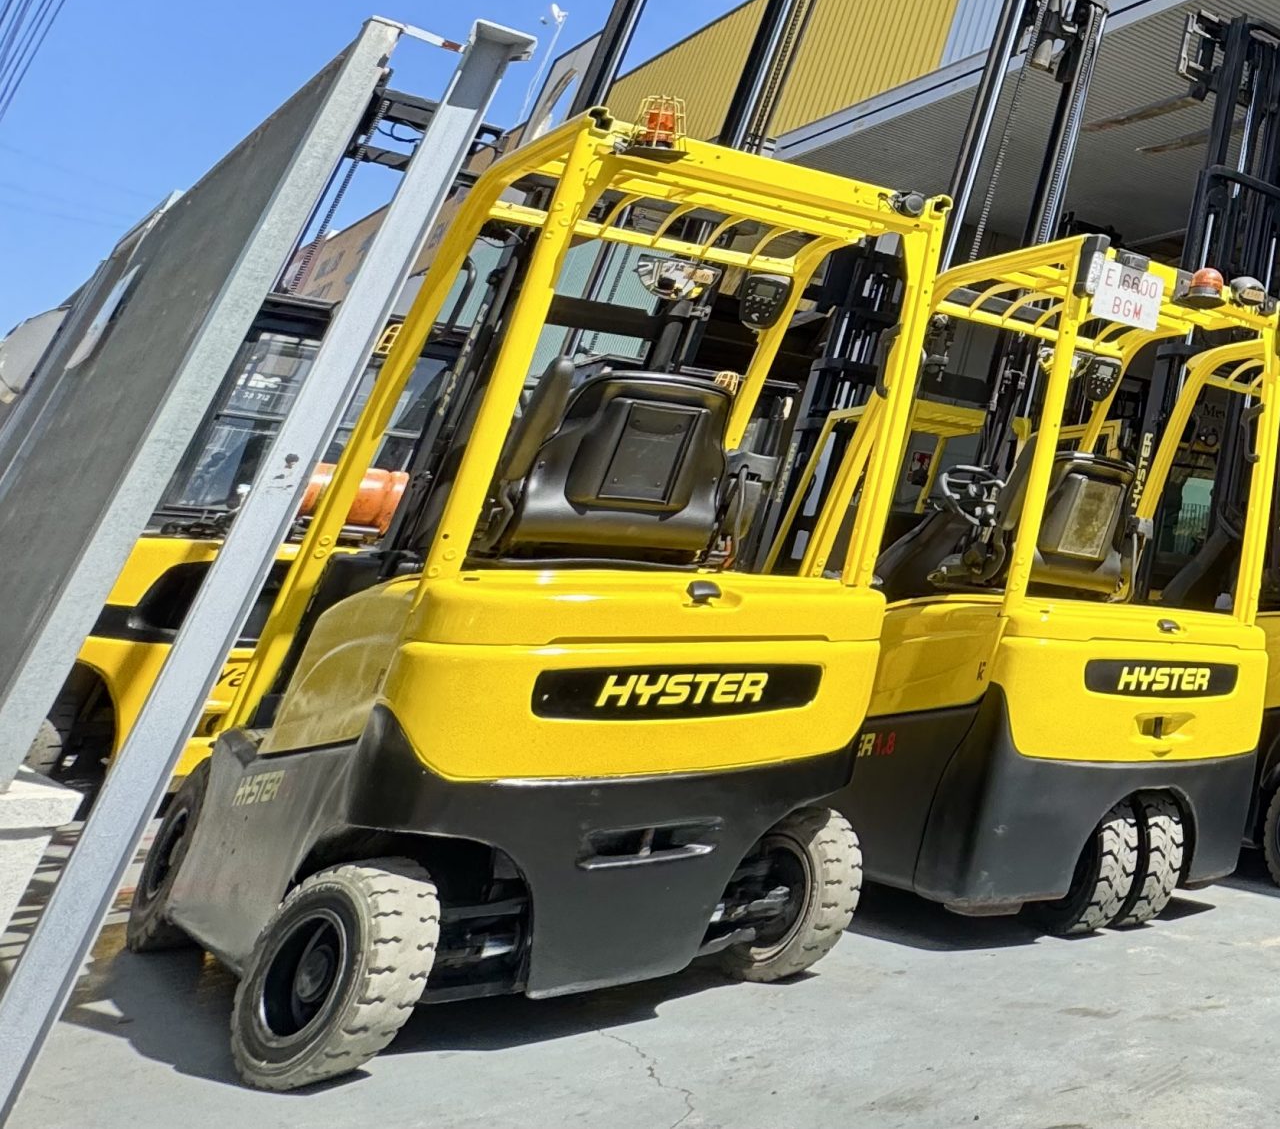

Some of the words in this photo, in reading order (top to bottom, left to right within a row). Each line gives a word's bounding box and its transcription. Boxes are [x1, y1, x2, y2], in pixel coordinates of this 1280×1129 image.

[1111, 296, 1143, 321] BGM
[1131, 432, 1154, 508] HYSTER
[595, 672, 769, 707] HYSTER
[1117, 666, 1211, 691] HYSTER
[231, 770, 285, 807] HYSTER
